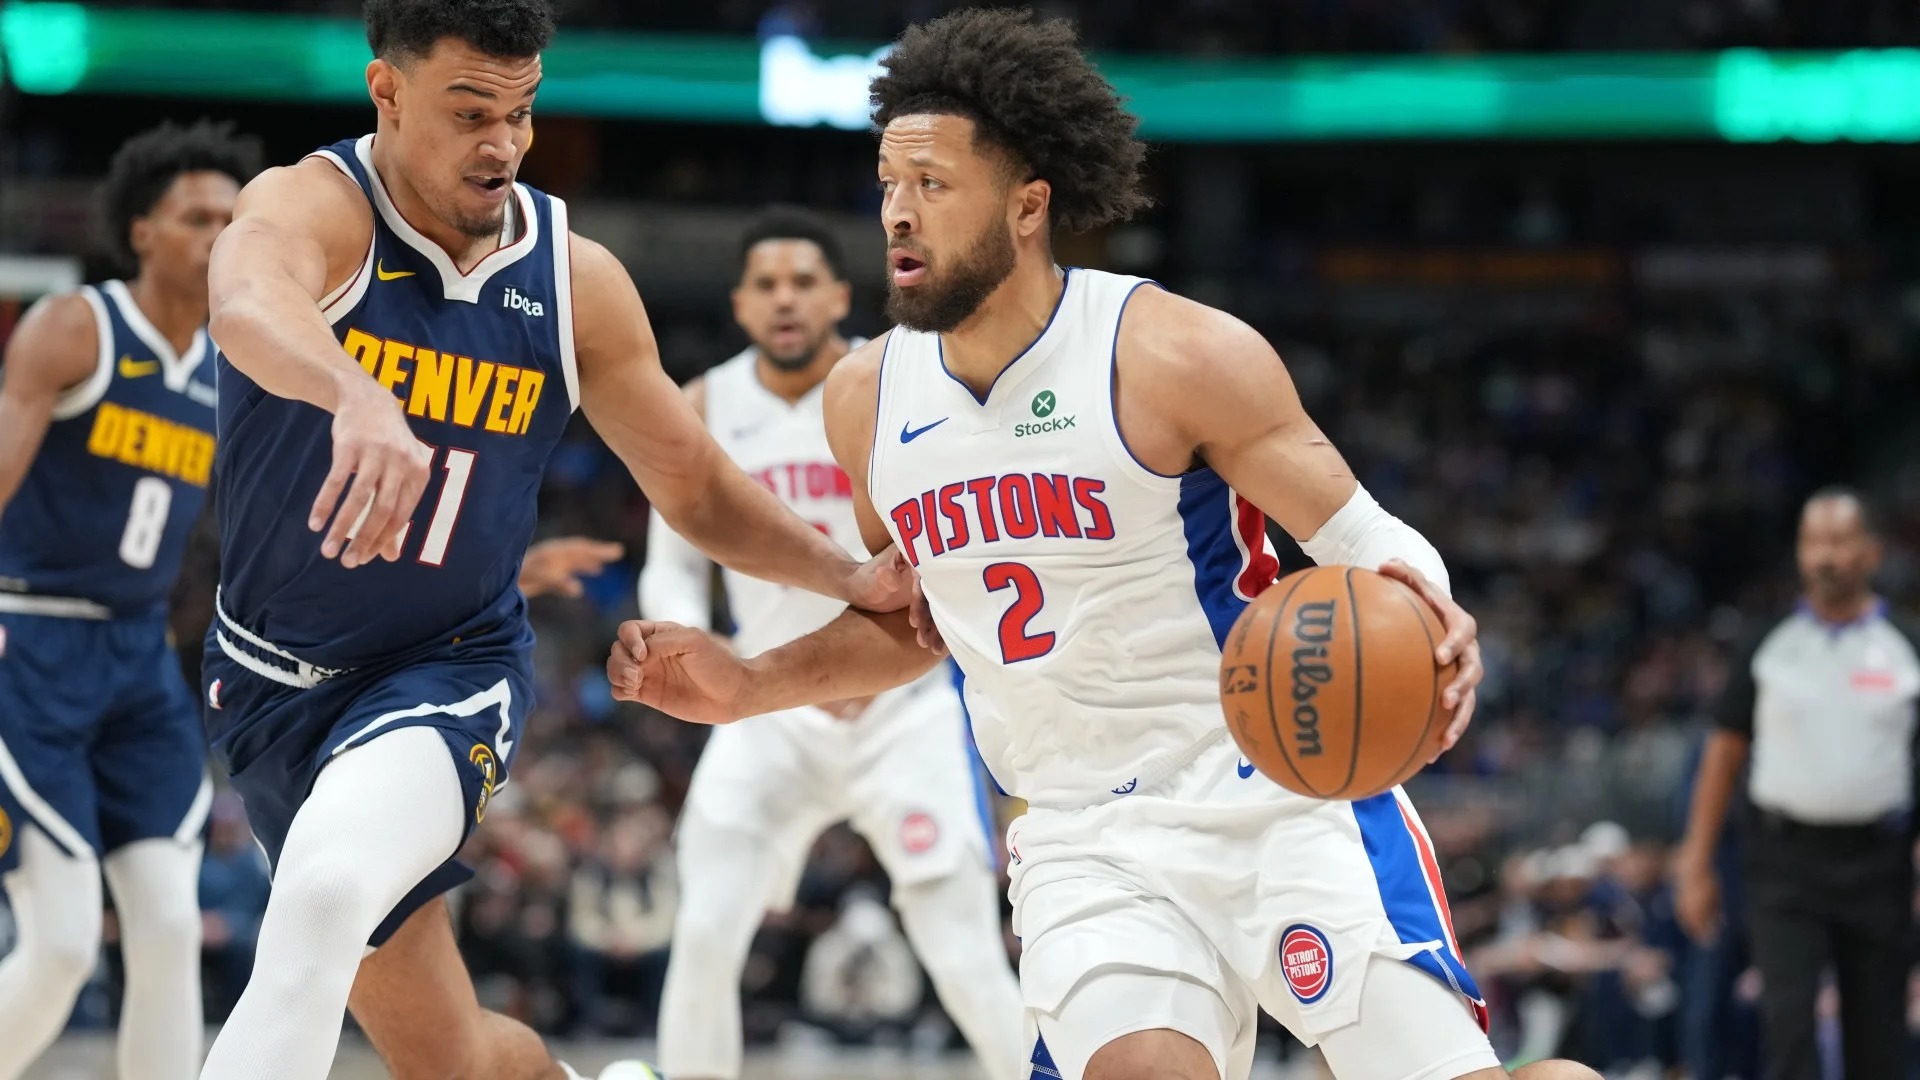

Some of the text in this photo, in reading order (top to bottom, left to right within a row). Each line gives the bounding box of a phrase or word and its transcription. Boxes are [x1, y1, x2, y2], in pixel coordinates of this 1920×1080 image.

[87, 401, 216, 488] DENVER
[1014, 414, 1076, 437] StockX
[119, 476, 172, 569] 8
[345, 437, 478, 568] 1
[890, 473, 1115, 567] PISTONS
[983, 562, 1055, 664] 2
[1292, 599, 1335, 757] Wilson
[1286, 948, 1319, 966] DETROIT
[1289, 961, 1322, 979] PISTONS
